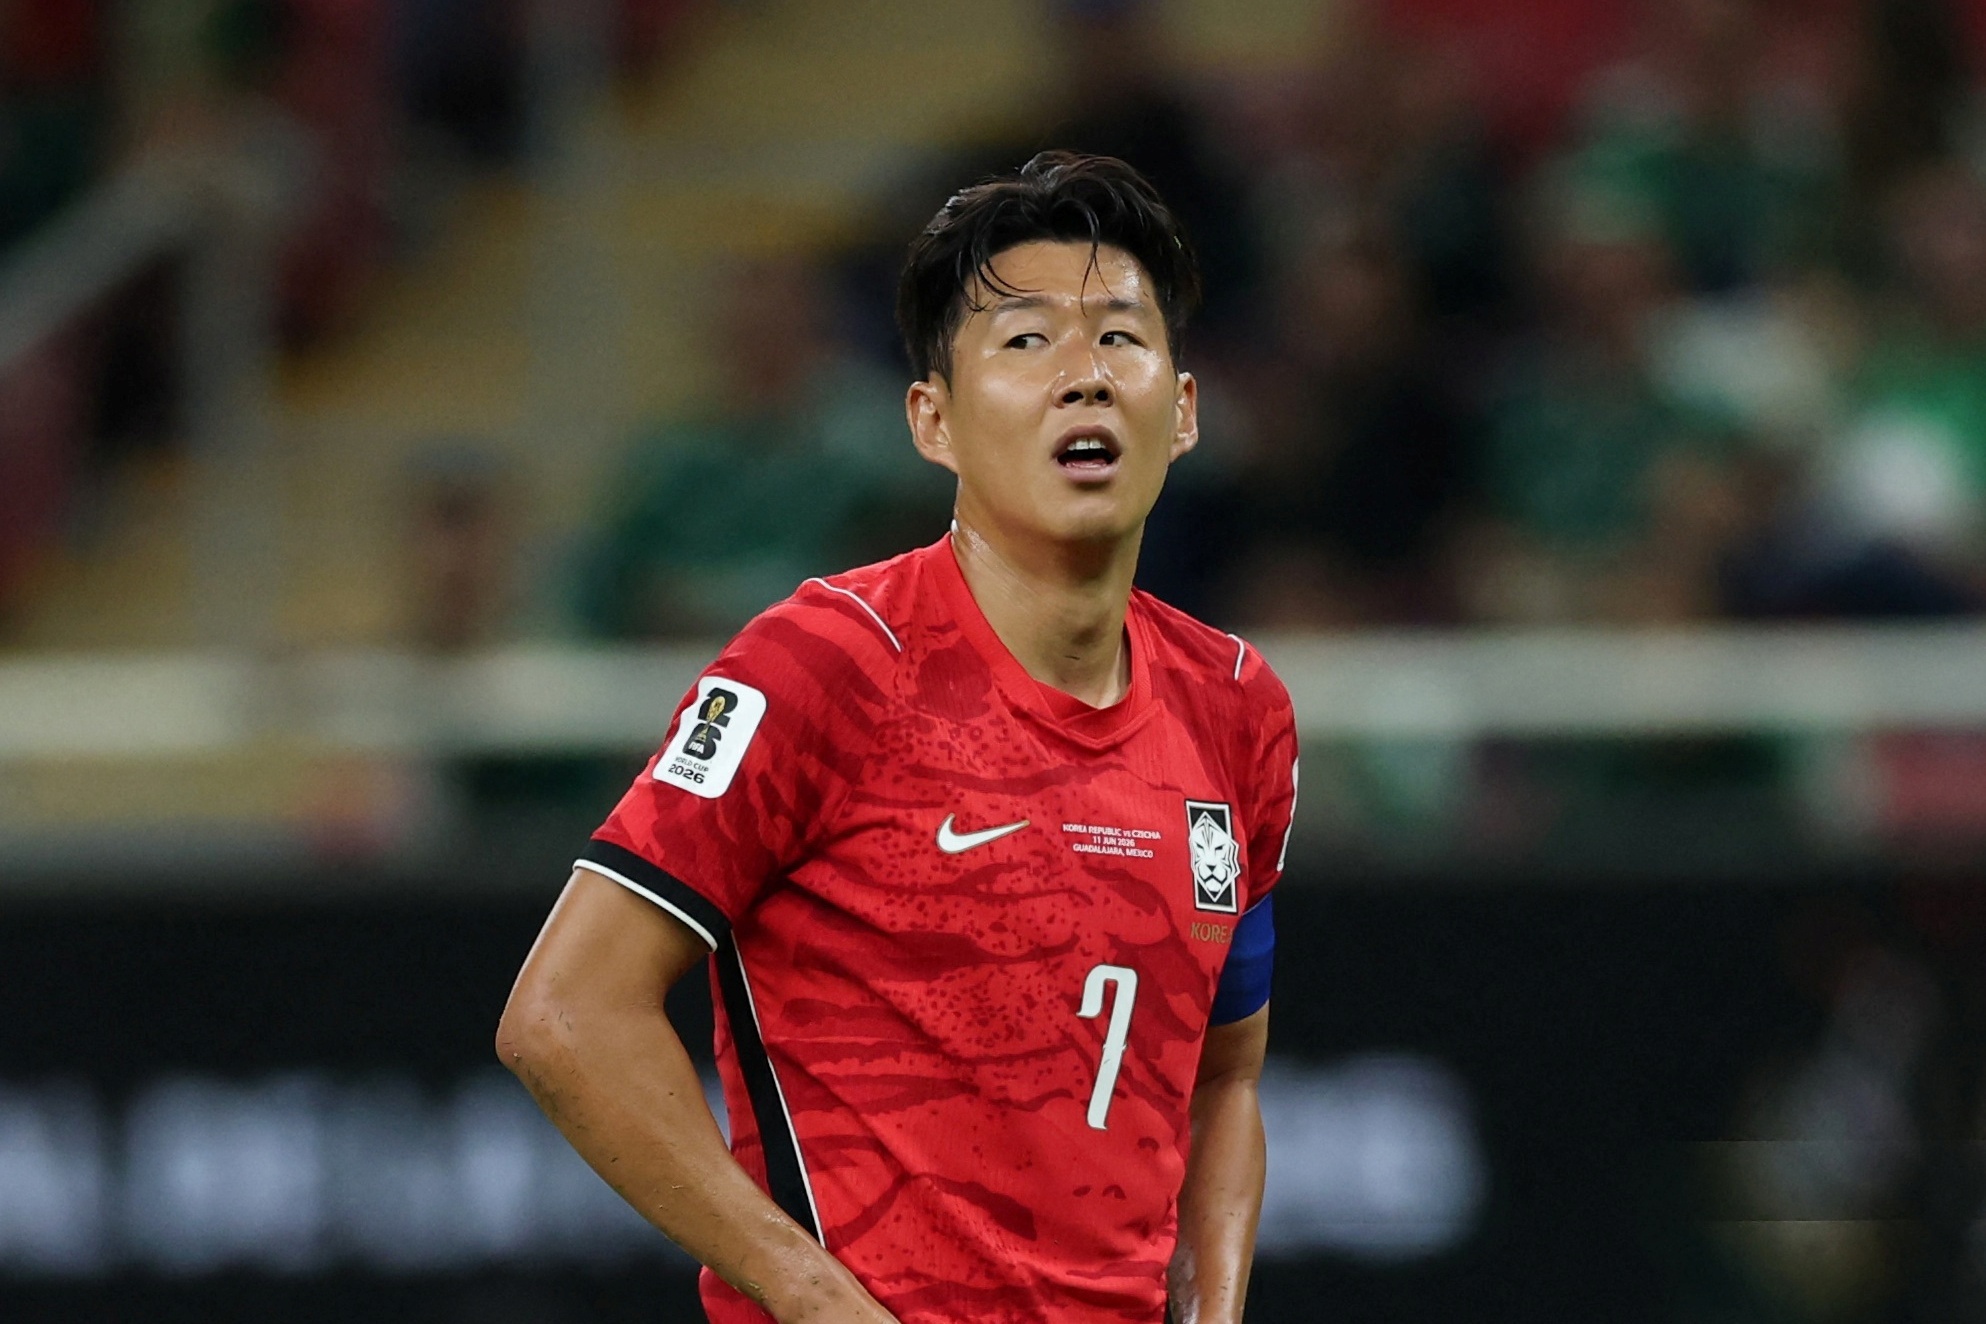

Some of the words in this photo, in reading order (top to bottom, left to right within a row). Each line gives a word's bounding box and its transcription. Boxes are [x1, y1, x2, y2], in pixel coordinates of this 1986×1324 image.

[668, 763, 705, 784] 2026
[693, 763, 709, 772] CUP
[1063, 824, 1087, 833] KOREA
[1089, 826, 1122, 836] REPUBLIC
[1092, 836, 1101, 844] 11
[1103, 837, 1117, 845] JUN
[1118, 838, 1135, 847] 2026
[1076, 964, 1138, 1130] 7
